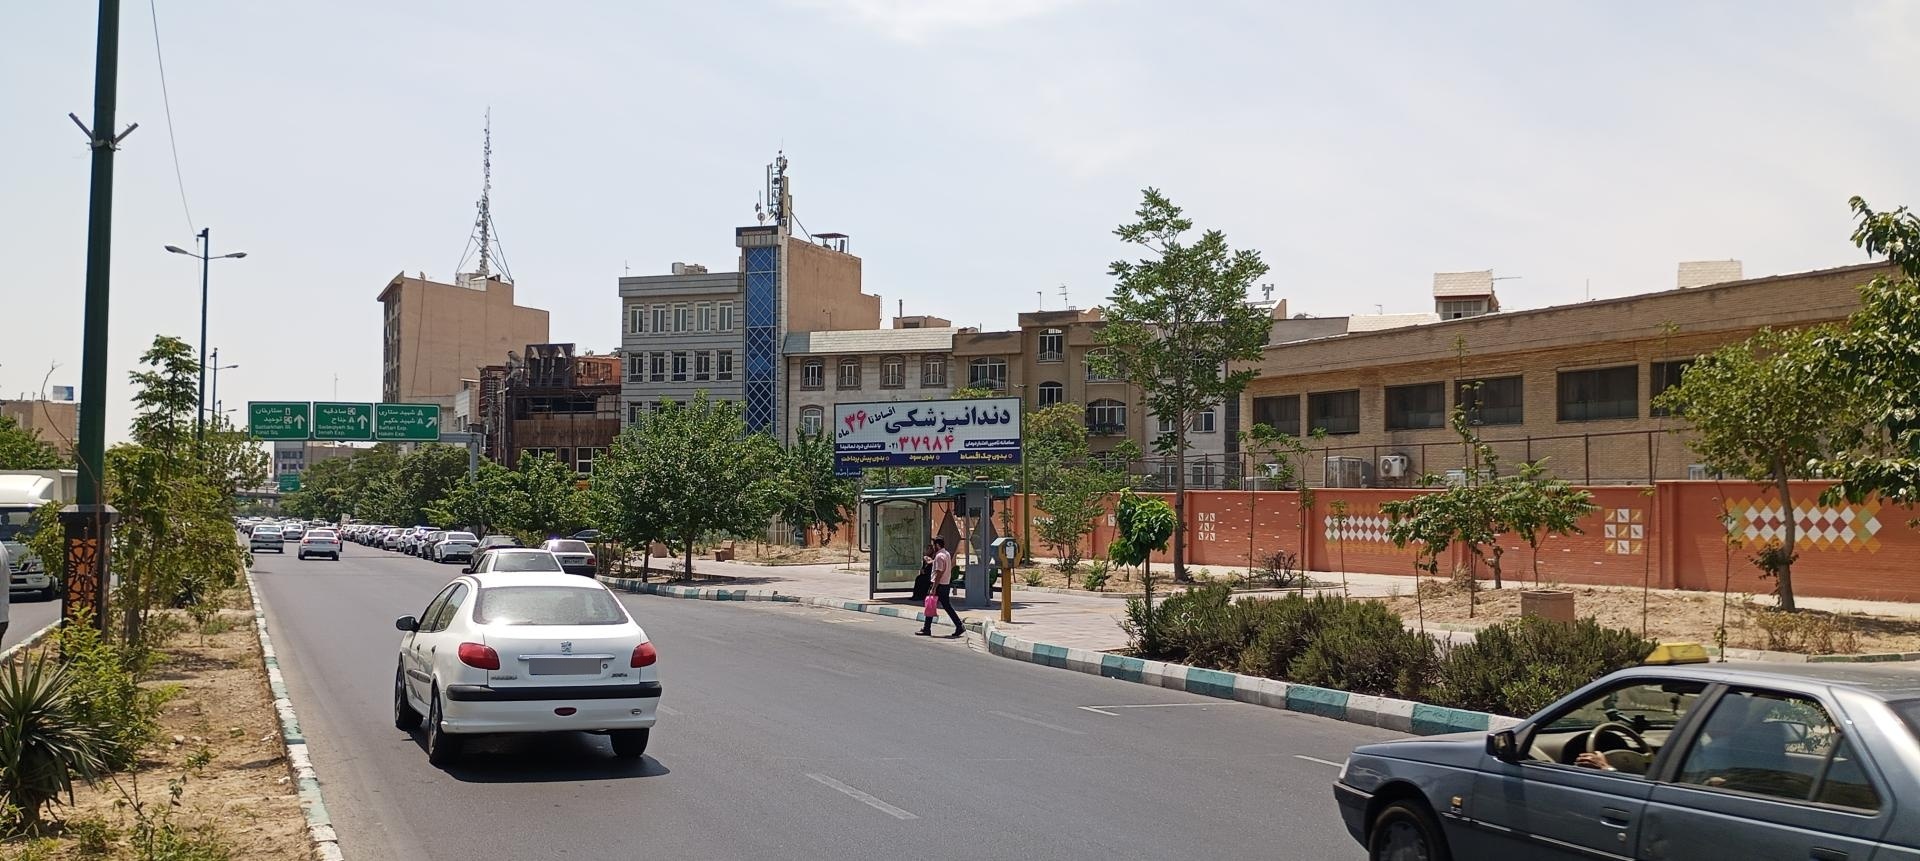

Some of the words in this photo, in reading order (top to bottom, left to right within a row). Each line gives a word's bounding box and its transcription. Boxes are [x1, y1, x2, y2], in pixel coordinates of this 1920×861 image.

[255, 407, 283, 415] ستارخان
[378, 409, 399, 417] ستاری
[875, 406, 895, 421] اقساط
[263, 416, 283, 424] توحید
[331, 416, 347, 424] جناح
[383, 417, 399, 425] حکیم
[845, 411, 866, 432] ۳۶
[867, 415, 875, 425] تا
[885, 405, 1010, 433] دندانپزشکی
[838, 428, 850, 439] ماه
[899, 435, 954, 451] ۳۷۹۸۴
[859, 454, 872, 463] پیش
[871, 455, 886, 463] بدون
[908, 454, 922, 462] سود
[921, 454, 935, 462] بدون
[960, 451, 981, 460] اقساط
[980, 452, 992, 461] چک
[991, 453, 1008, 461] بدون
